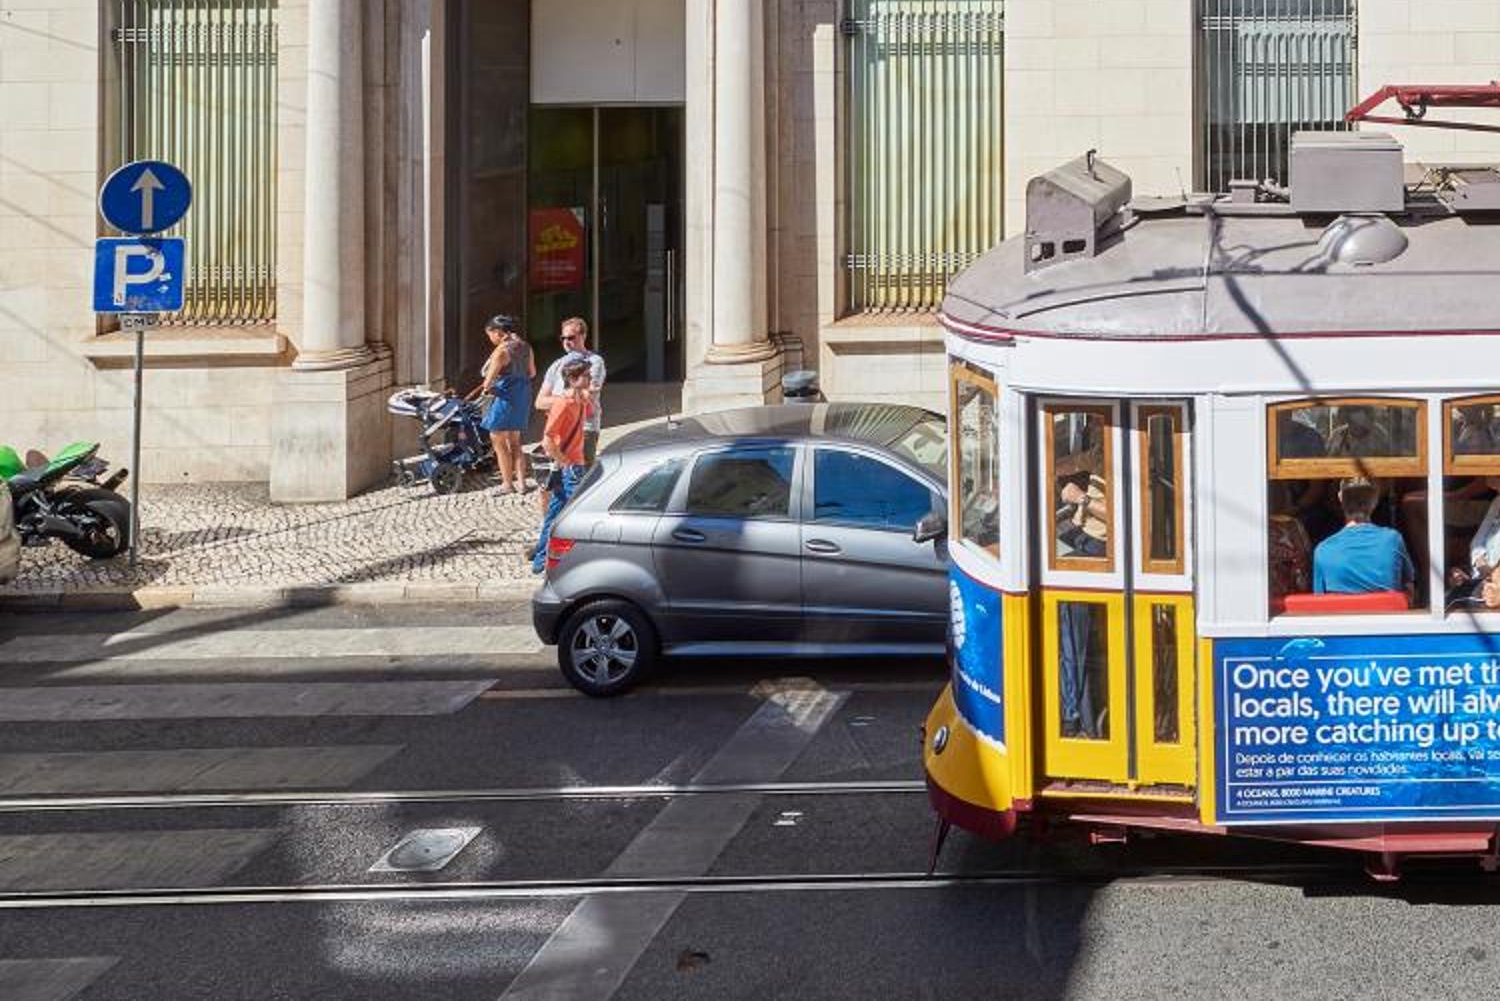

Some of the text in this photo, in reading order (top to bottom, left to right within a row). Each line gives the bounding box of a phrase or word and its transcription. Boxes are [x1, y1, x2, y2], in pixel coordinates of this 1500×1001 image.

[114, 245, 165, 306] P
[1233, 664, 1310, 690] Once
[1316, 661, 1411, 694] you've
[1418, 663, 1474, 686] met
[1233, 692, 1320, 721] locals,
[1327, 690, 1400, 717] there
[1407, 688, 1455, 715] will
[1234, 724, 1309, 746] more
[1315, 719, 1435, 749] catching
[1442, 721, 1480, 746] up
[1235, 752, 1276, 766] Depois
[1277, 751, 1295, 764] de
[1296, 751, 1352, 764] conhecer
[1235, 766, 1263, 779] estar
[1276, 766, 1295, 780] par
